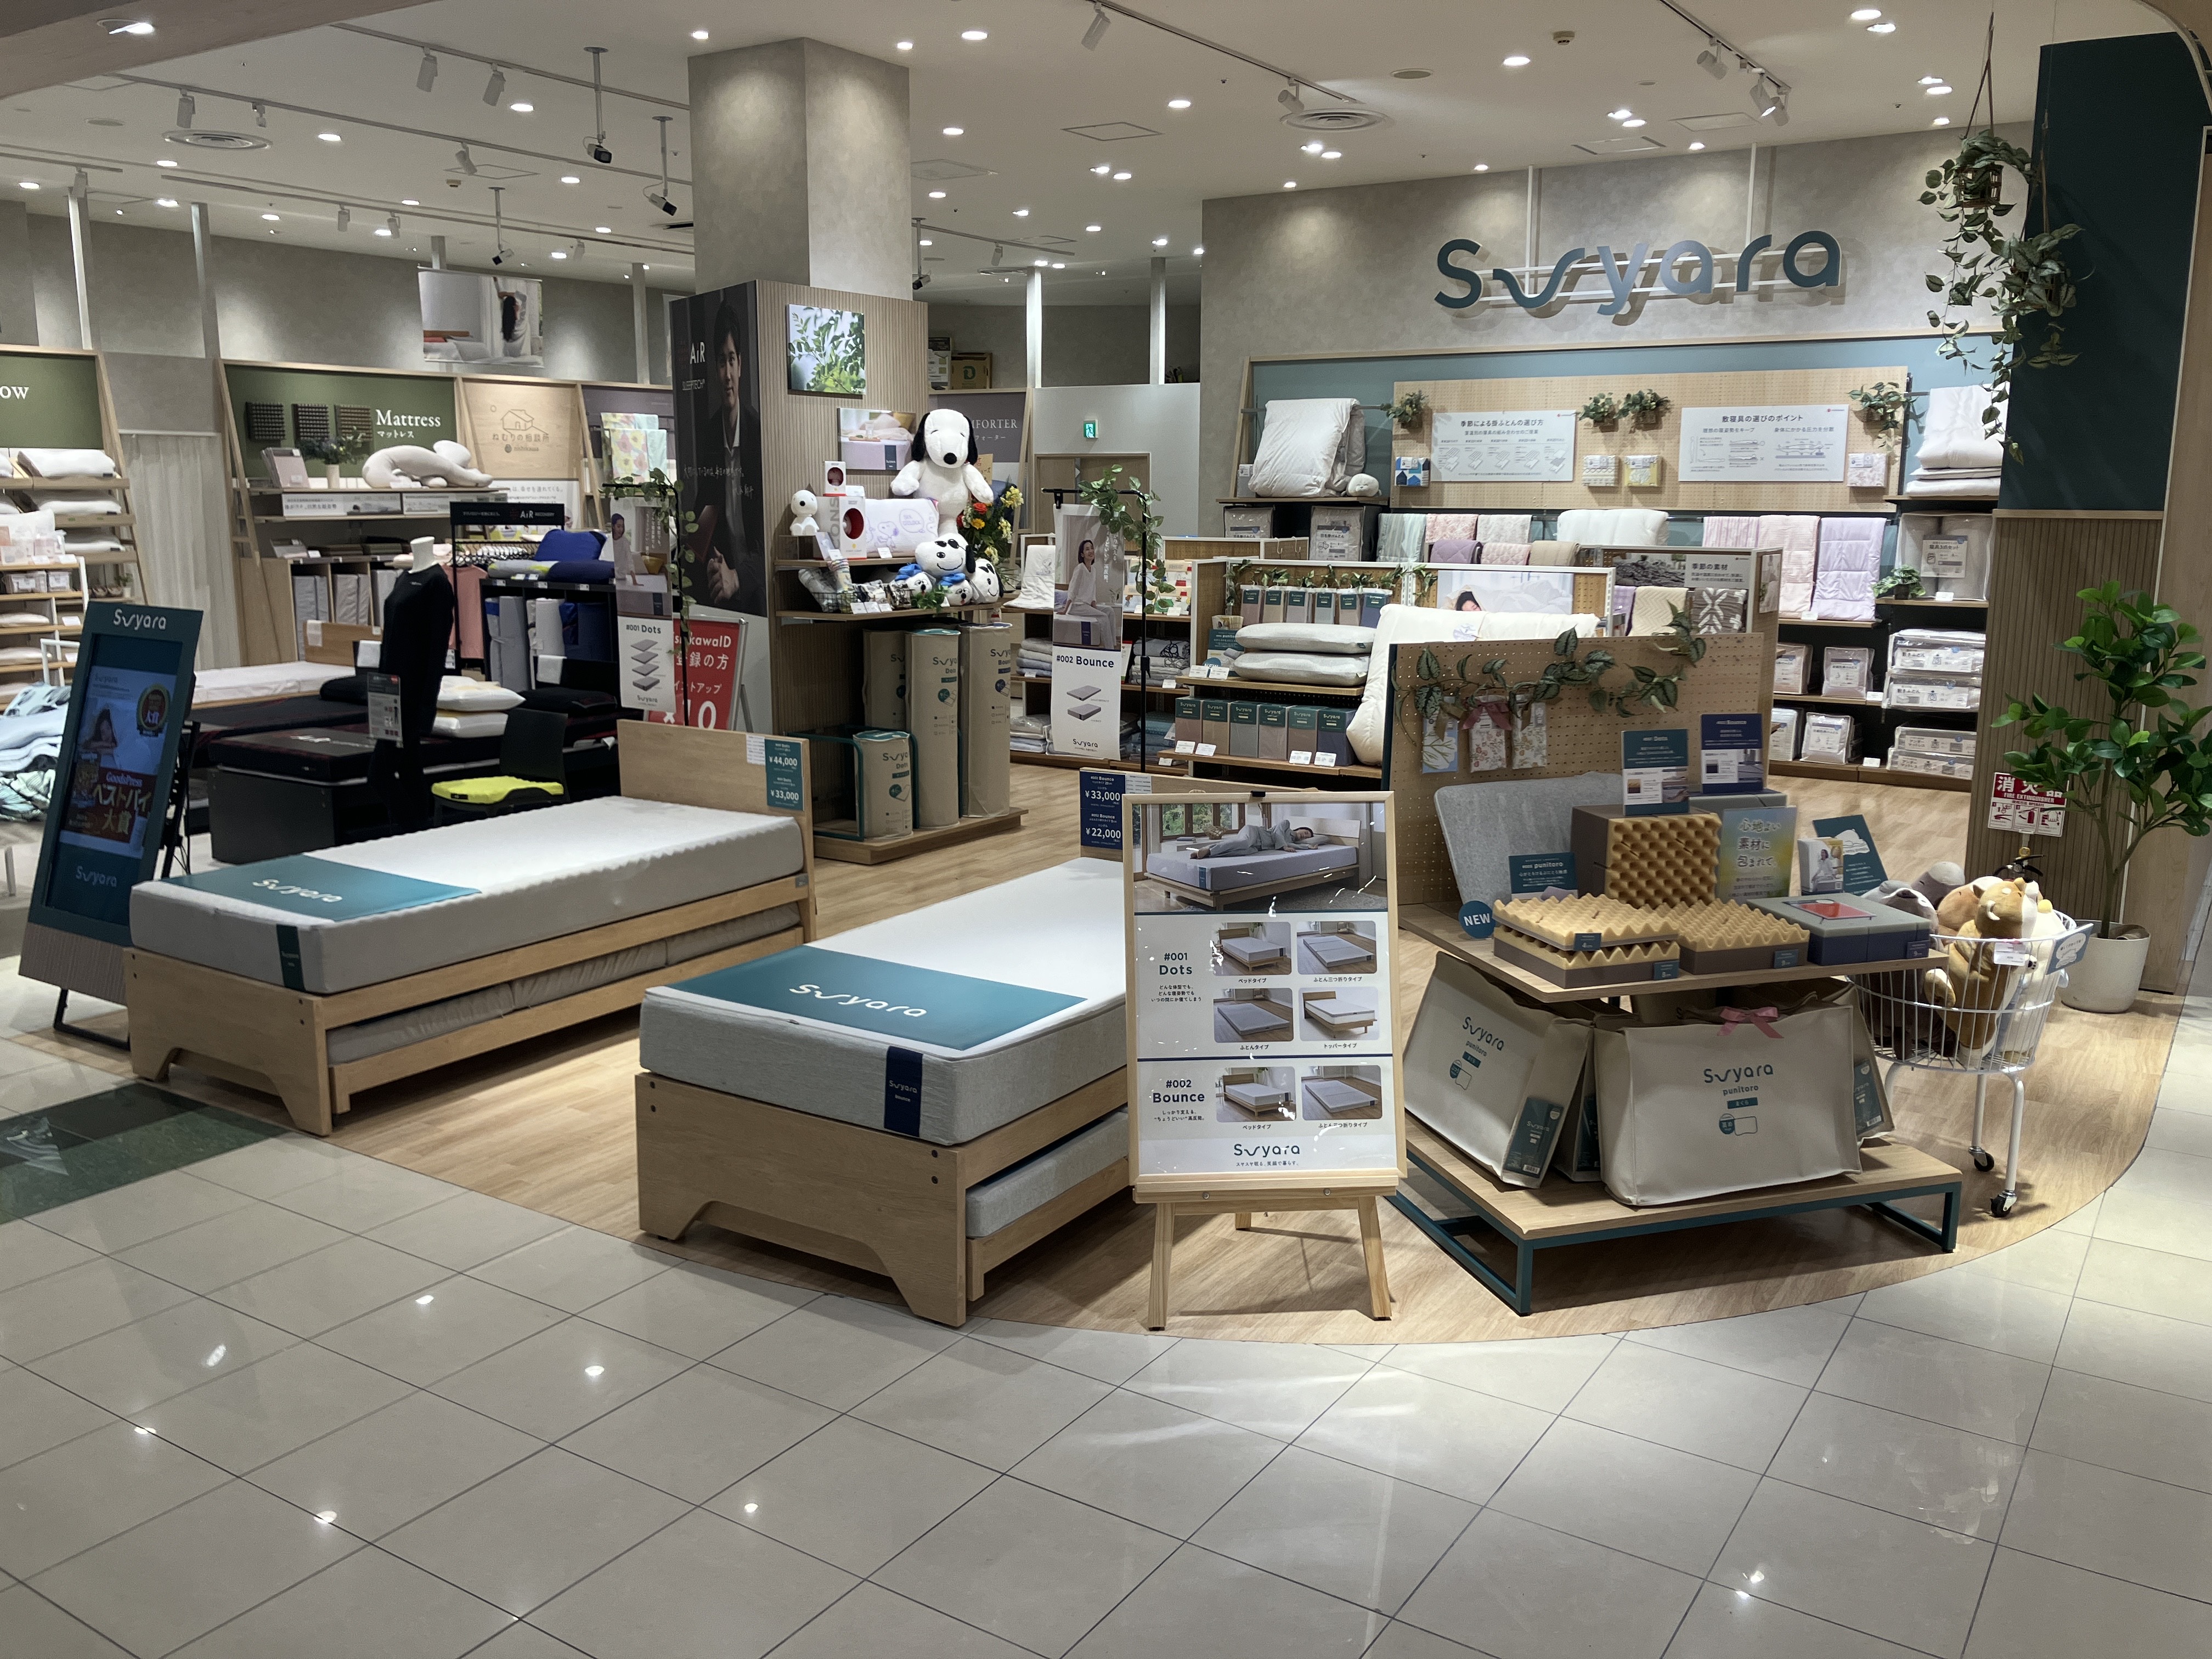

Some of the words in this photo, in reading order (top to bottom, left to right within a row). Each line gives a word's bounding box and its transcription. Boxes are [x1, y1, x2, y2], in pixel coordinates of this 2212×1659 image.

[1434, 230, 1842, 316] Suyara
[375, 409, 441, 427] Mattress
[377, 430, 414, 439] マットレス
[641, 625, 661, 634] Dots
[1056, 654, 1074, 664] #002
[1076, 656, 1114, 668] Bounce
[769, 756, 798, 767] ¥44,000
[771, 789, 799, 801] ¥33,000
[1085, 790, 1120, 802] ¥33,000
[1086, 827, 1121, 839] ¥22,000
[1737, 837, 1771, 851] 素材に
[1463, 912, 1491, 927] NEW
[1164, 952, 1188, 961] #001
[1159, 964, 1193, 975] Dots
[789, 984, 927, 1018] Suyara
[1462, 1016, 1505, 1052] Suyara
[1703, 1064, 1774, 1084] Suyara
[889, 1080, 917, 1093] Suyara
[1166, 1079, 1192, 1088] #002
[1723, 1084, 1759, 1096] punitoro
[1153, 1092, 1205, 1103] Bounce
[1233, 1143, 1300, 1158] Suyara
